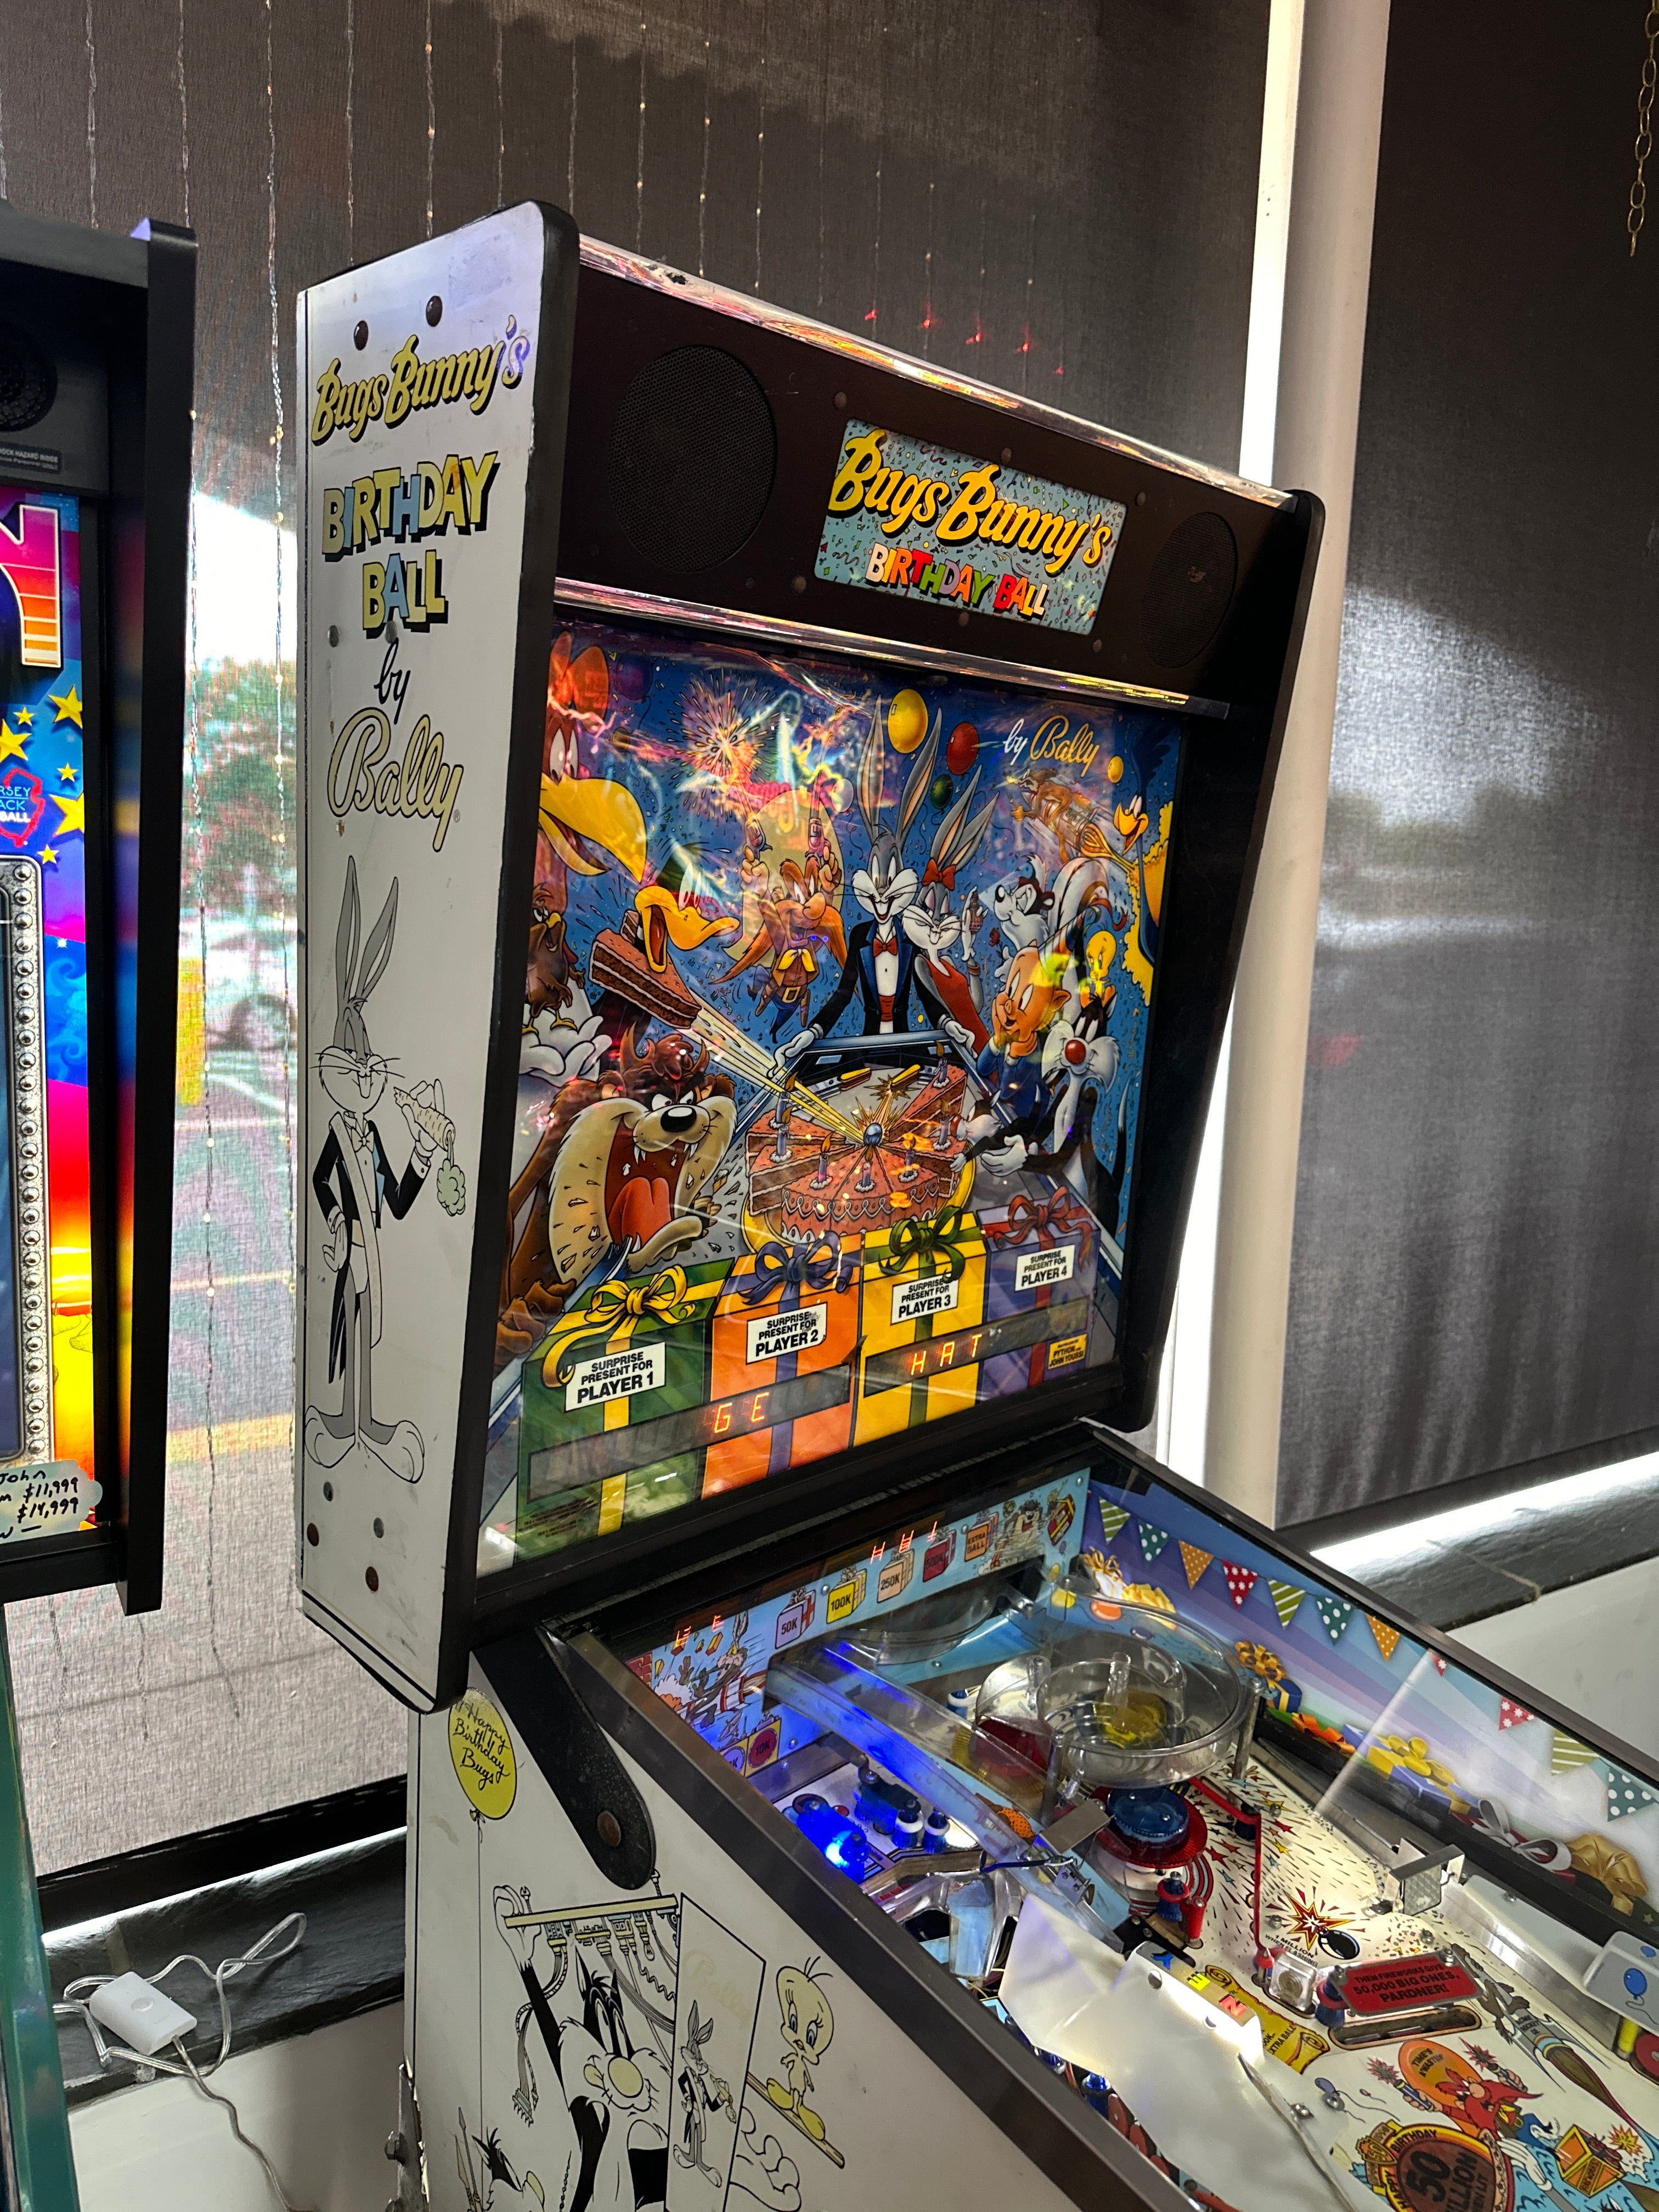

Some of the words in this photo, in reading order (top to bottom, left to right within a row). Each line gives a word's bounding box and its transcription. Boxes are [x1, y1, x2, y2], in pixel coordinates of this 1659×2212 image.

[311, 358, 390, 447] Bugs
[385, 314, 531, 430] Bunny's
[323, 451, 500, 562] BIRTHDAY
[828, 428, 950, 538] Bugs
[935, 464, 1113, 577] Bunny's
[864, 543, 997, 607] BIRTHDAY
[993, 574, 1049, 620] BALL
[363, 549, 448, 639] BALL
[374, 637, 411, 725] by
[1003, 718, 1028, 765] by
[1030, 715, 1100, 777] Bally
[327, 707, 464, 853] Bally
[1024, 1260, 1053, 1273] PRESENT
[1054, 1257, 1066, 1266] FOR
[1030, 1250, 1061, 1263] SURPRISE
[908, 1278, 944, 1293] SURPRISE
[1021, 1267, 1059, 1287] PLAYER
[1061, 1266, 1068, 1277] 4
[899, 1296, 942, 1318] PLAYER
[944, 1294, 951, 1306] 3
[901, 1289, 934, 1304] PRESENT
[935, 1285, 950, 1295] FOR
[758, 1324, 799, 1340] PRESENT
[800, 1319, 817, 1330] FOR
[767, 1311, 810, 1329] SURPRISE
[755, 1332, 808, 1357] PLAYER
[810, 1329, 819, 1343] 2
[581, 1365, 631, 1386] PRESENT
[631, 1359, 653, 1373] FOR
[591, 1351, 644, 1373] SURPRISE
[577, 1375, 642, 1404] PLAYER
[647, 1371, 653, 1385] 1
[22, 1476, 78, 1504] $11,999
[17, 1497, 79, 1524] $14,999
[880, 1572, 901, 1591] 250K
[830, 1593, 852, 1612] 100K
[781, 1617, 798, 1635] 50K
[453, 1718, 511, 1784] Birthday
[460, 1747, 495, 1791] Bugs
[1280, 1937, 1314, 1959] MILLION
[1378, 1966, 1425, 1980] FIREWORKS
[1353, 1980, 1396, 1995] 50,000
[1395, 1976, 1420, 1988] BIG
[1379, 1983, 1450, 2003] PARDNER!
[1281, 2027, 1297, 2040] BALL
[1390, 2129, 1437, 2154] BIRTHDAY
[1406, 2151, 1451, 2203] 50
